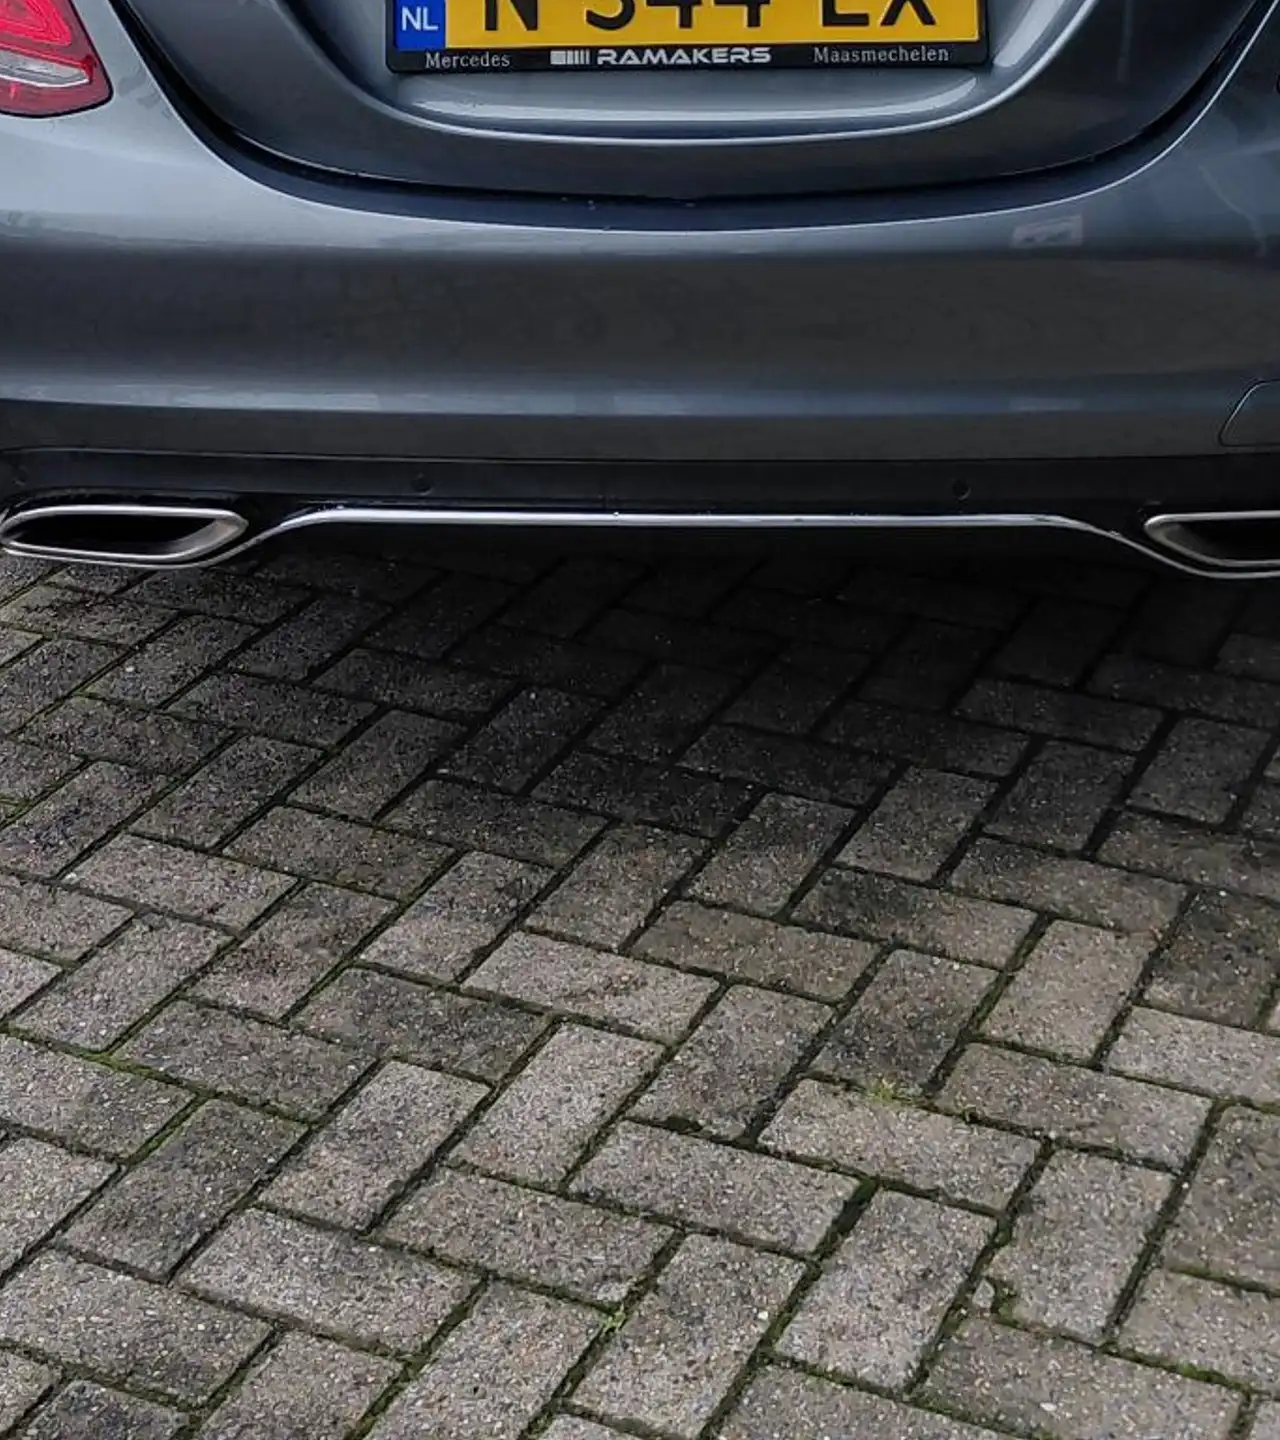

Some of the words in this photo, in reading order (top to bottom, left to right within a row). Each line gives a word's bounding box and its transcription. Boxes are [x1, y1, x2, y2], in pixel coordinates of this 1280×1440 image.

[401, 6, 439, 32] NL
[424, 51, 511, 69] Mercedes
[596, 47, 771, 66] RAMAKERS
[813, 46, 950, 64] Maasmechelen
